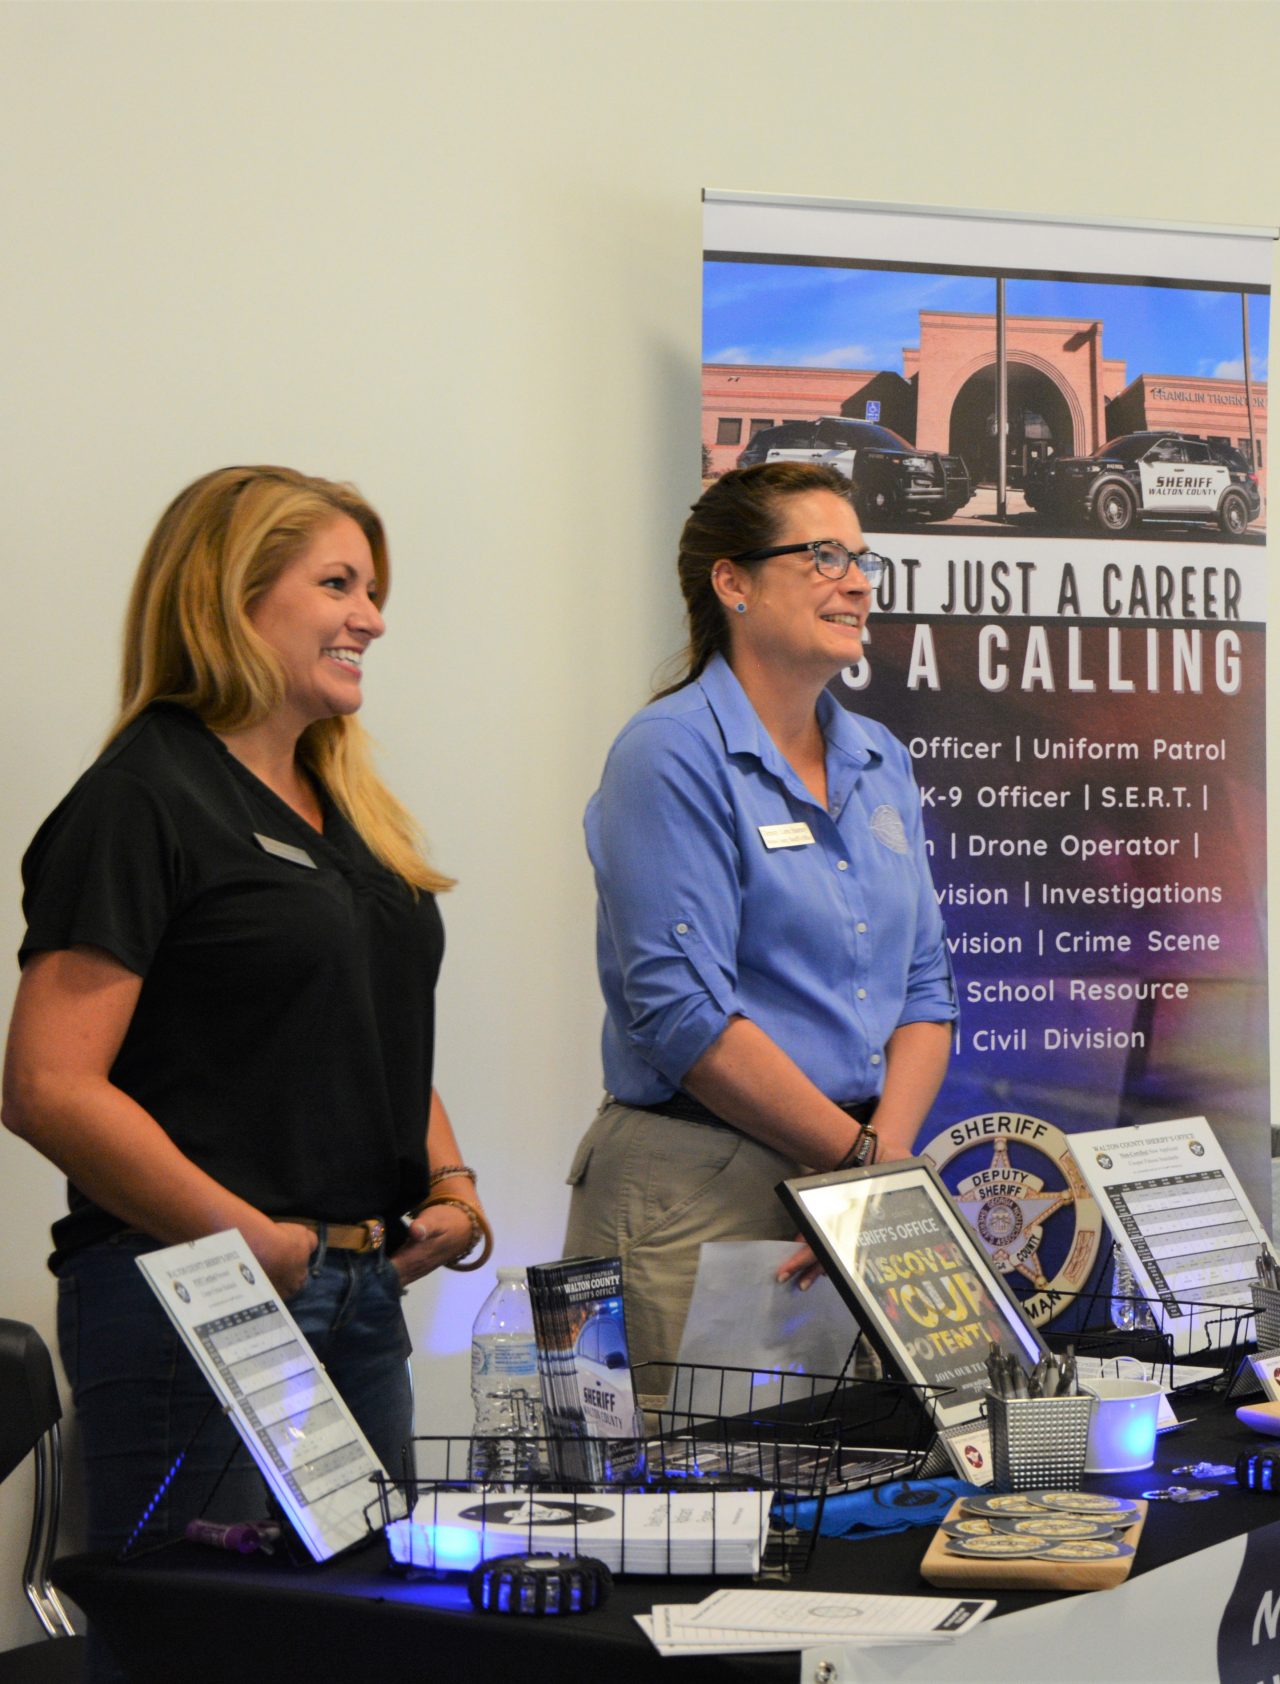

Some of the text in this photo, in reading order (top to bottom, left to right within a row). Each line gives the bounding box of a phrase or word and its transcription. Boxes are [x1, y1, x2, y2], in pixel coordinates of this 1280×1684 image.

[1152, 388, 1264, 407] FRANKLIN THORNON
[1149, 488, 1218, 497] WALTON COUNTY
[1156, 476, 1213, 488] SHERIFF
[877, 556, 1245, 621] OT JUST A CAREER
[841, 623, 1243, 695] S A CALLING
[909, 737, 1002, 760] Officer
[1033, 738, 1139, 760] Uniform
[1153, 738, 1226, 761] Patrol
[920, 786, 963, 807] K-9
[977, 785, 1072, 808] Officer
[1101, 786, 1192, 808] S.E.R.T.
[968, 834, 1048, 857] Drone
[1060, 834, 1180, 861] Operator
[934, 883, 1009, 906] vision
[1042, 882, 1223, 909] Investigations
[946, 931, 1022, 954] vision
[1055, 931, 1132, 954] Crime
[1147, 930, 1221, 952] Scene
[967, 979, 1190, 1003] School Resource
[972, 1029, 1027, 1052] Civil
[1044, 1027, 1146, 1050] Division
[950, 1116, 1048, 1146] SHERIFF
[972, 1169, 1029, 1187] DEPUTY
[978, 1184, 1022, 1200] SHERIFF
[855, 1218, 939, 1248] ERIFF'S OFFICE
[1016, 1235, 1040, 1262] COUNTY
[564, 1275, 620, 1294] WALTON COUNTY
[1021, 1288, 1062, 1320] MAN
[905, 1319, 1002, 1361] POTENTI
[935, 1361, 988, 1383] JOIN OUR TEA
[584, 1387, 615, 1412] SHERIFF
